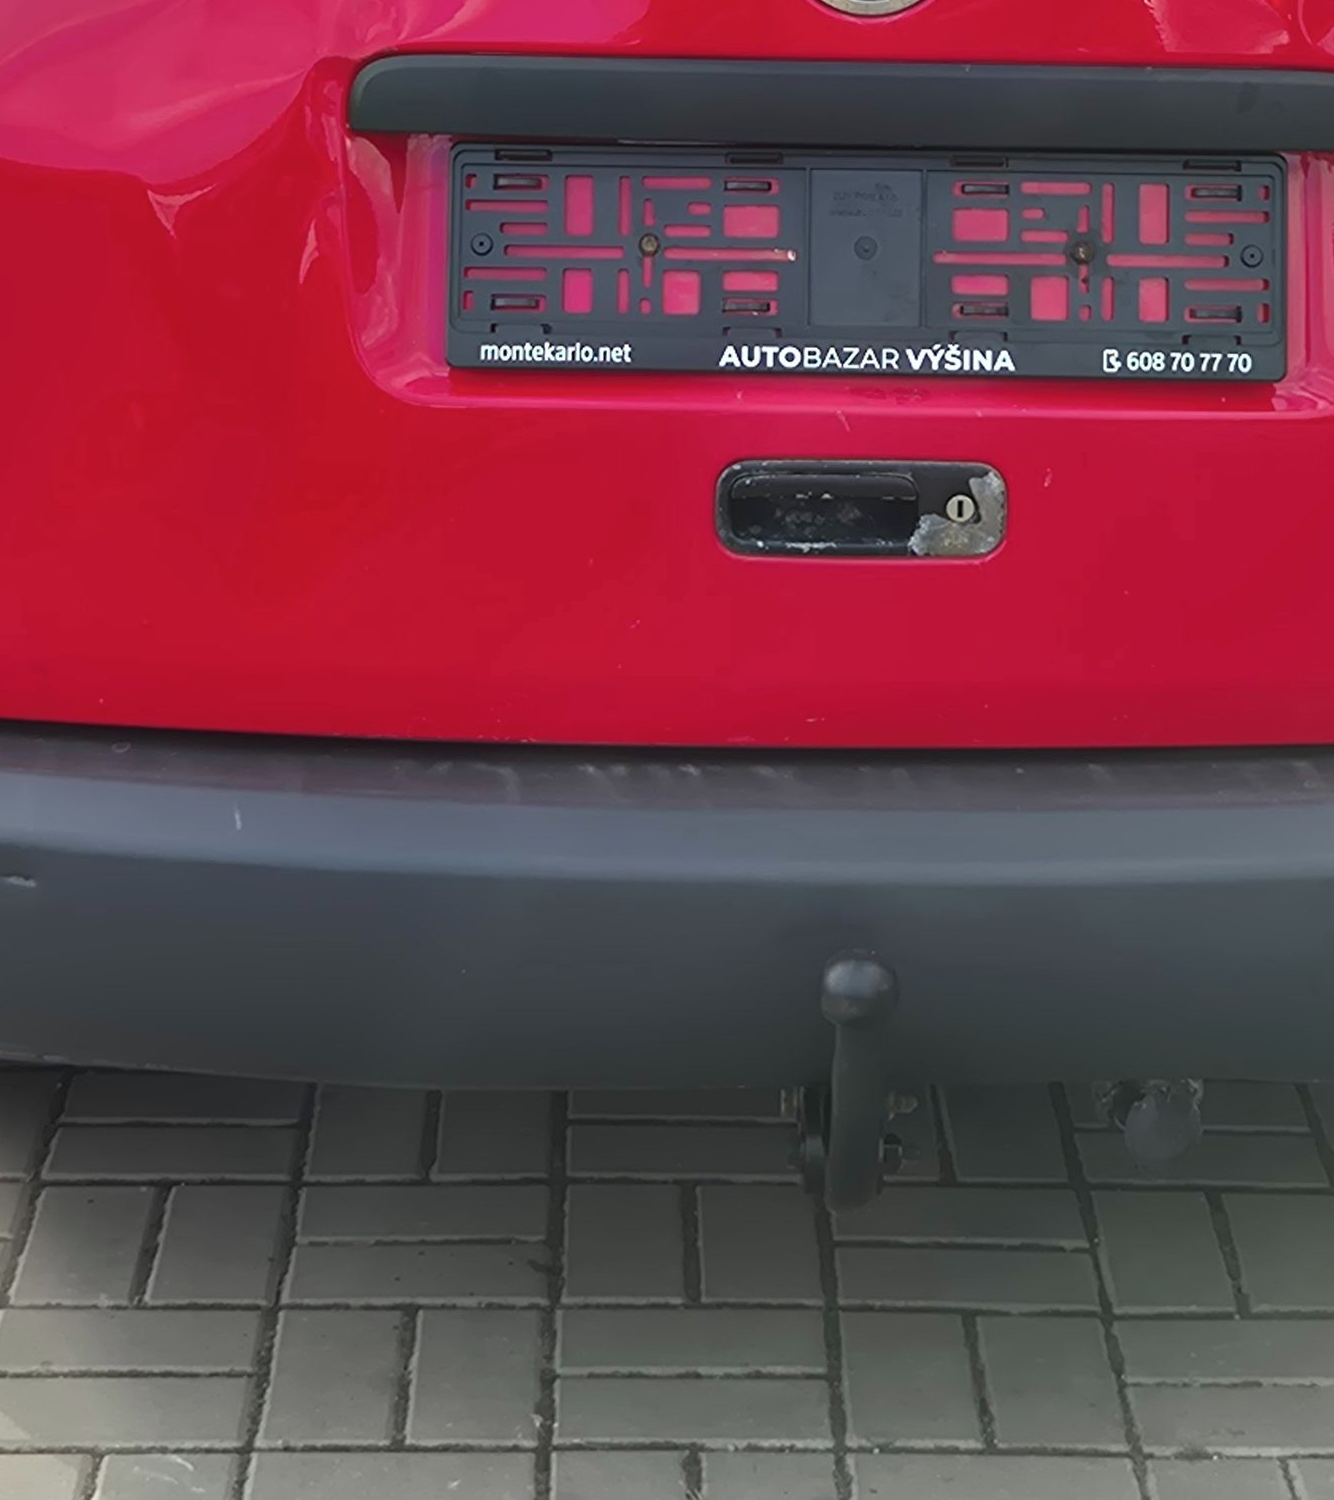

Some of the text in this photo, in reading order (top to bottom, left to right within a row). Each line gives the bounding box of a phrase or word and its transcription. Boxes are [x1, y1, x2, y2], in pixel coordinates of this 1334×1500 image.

[480, 341, 632, 363] montekarlo.net
[719, 343, 1015, 372] AUTOBAZAR VÝŠINA
[1126, 351, 1252, 373] 608 70 77 70
